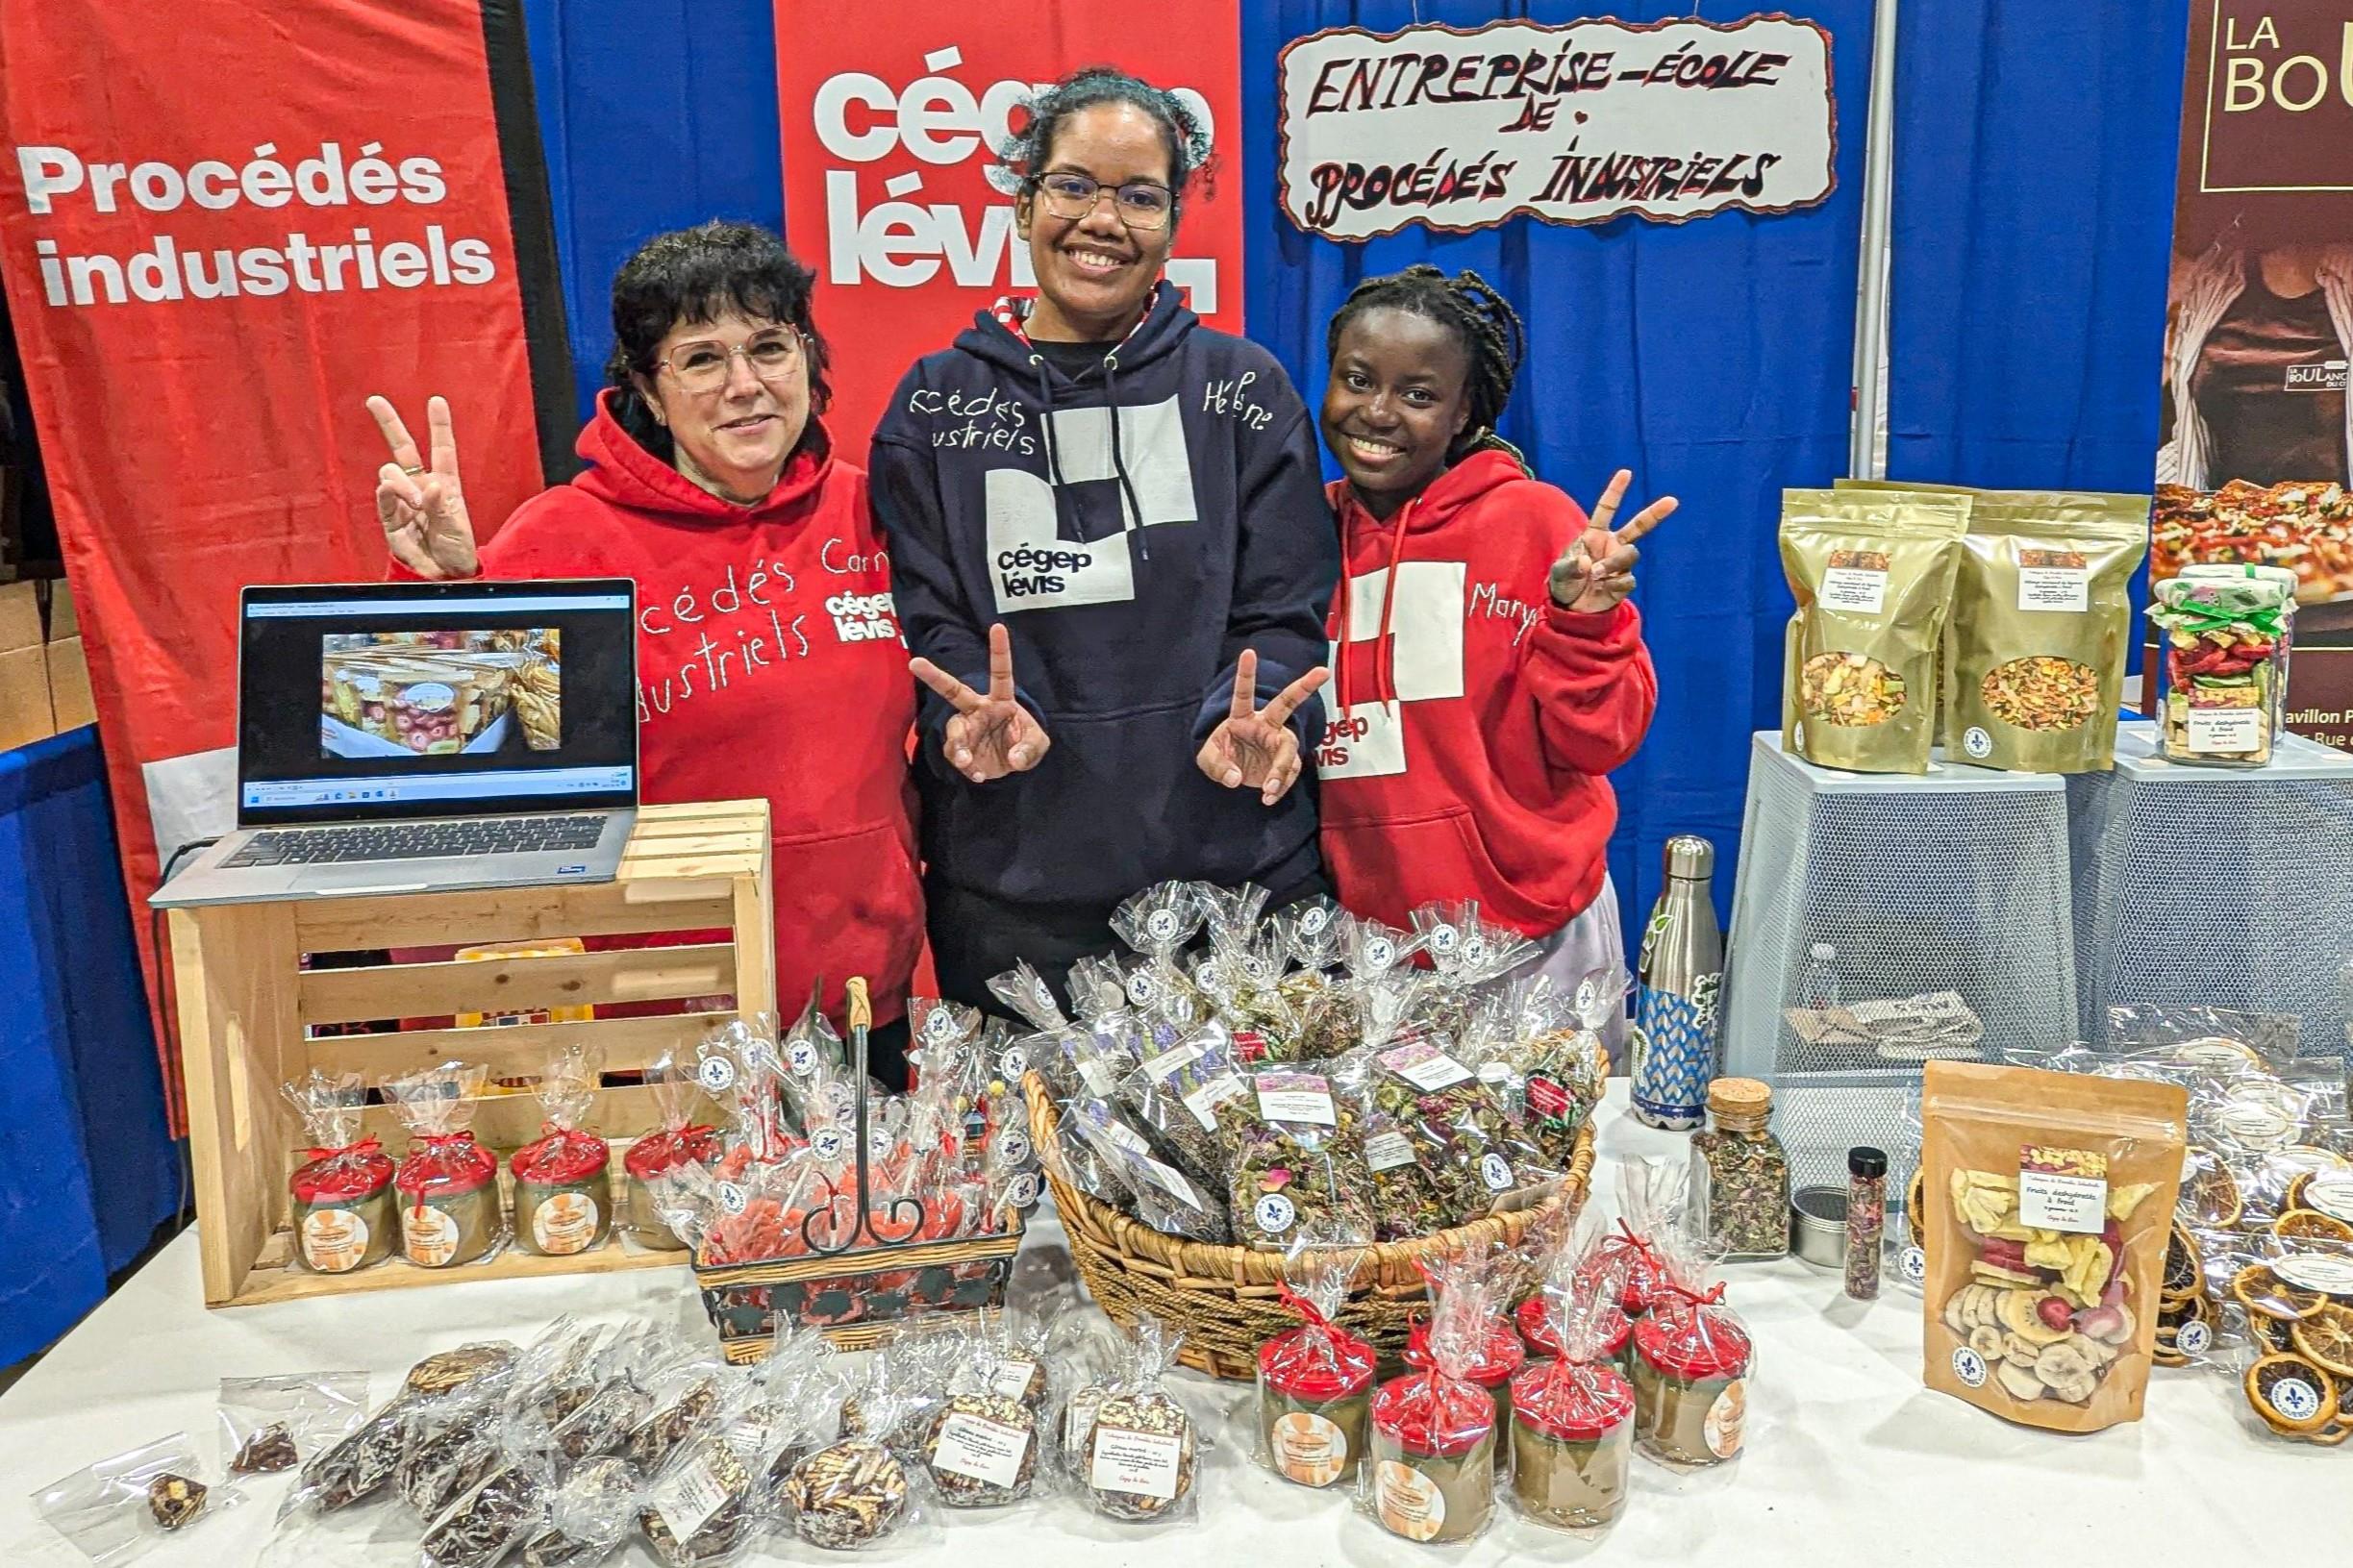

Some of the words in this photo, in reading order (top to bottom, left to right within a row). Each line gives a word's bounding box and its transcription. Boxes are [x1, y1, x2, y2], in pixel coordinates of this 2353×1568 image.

[2226, 16, 2280, 50] LA
[814, 45, 1215, 195] cégp
[1498, 95, 1559, 133] DE
[16, 141, 446, 214] Procédés
[1304, 147, 1516, 228] PROCÉDÉS
[1529, 136, 1782, 205] INDUSTRIELS
[825, 169, 1039, 288] lévi
[37, 224, 496, 306] industriels
[997, 542, 1092, 574] cégep
[1001, 571, 1065, 599] lévis
[833, 615, 896, 642] lévis
[2285, 709, 2340, 724] avillon
